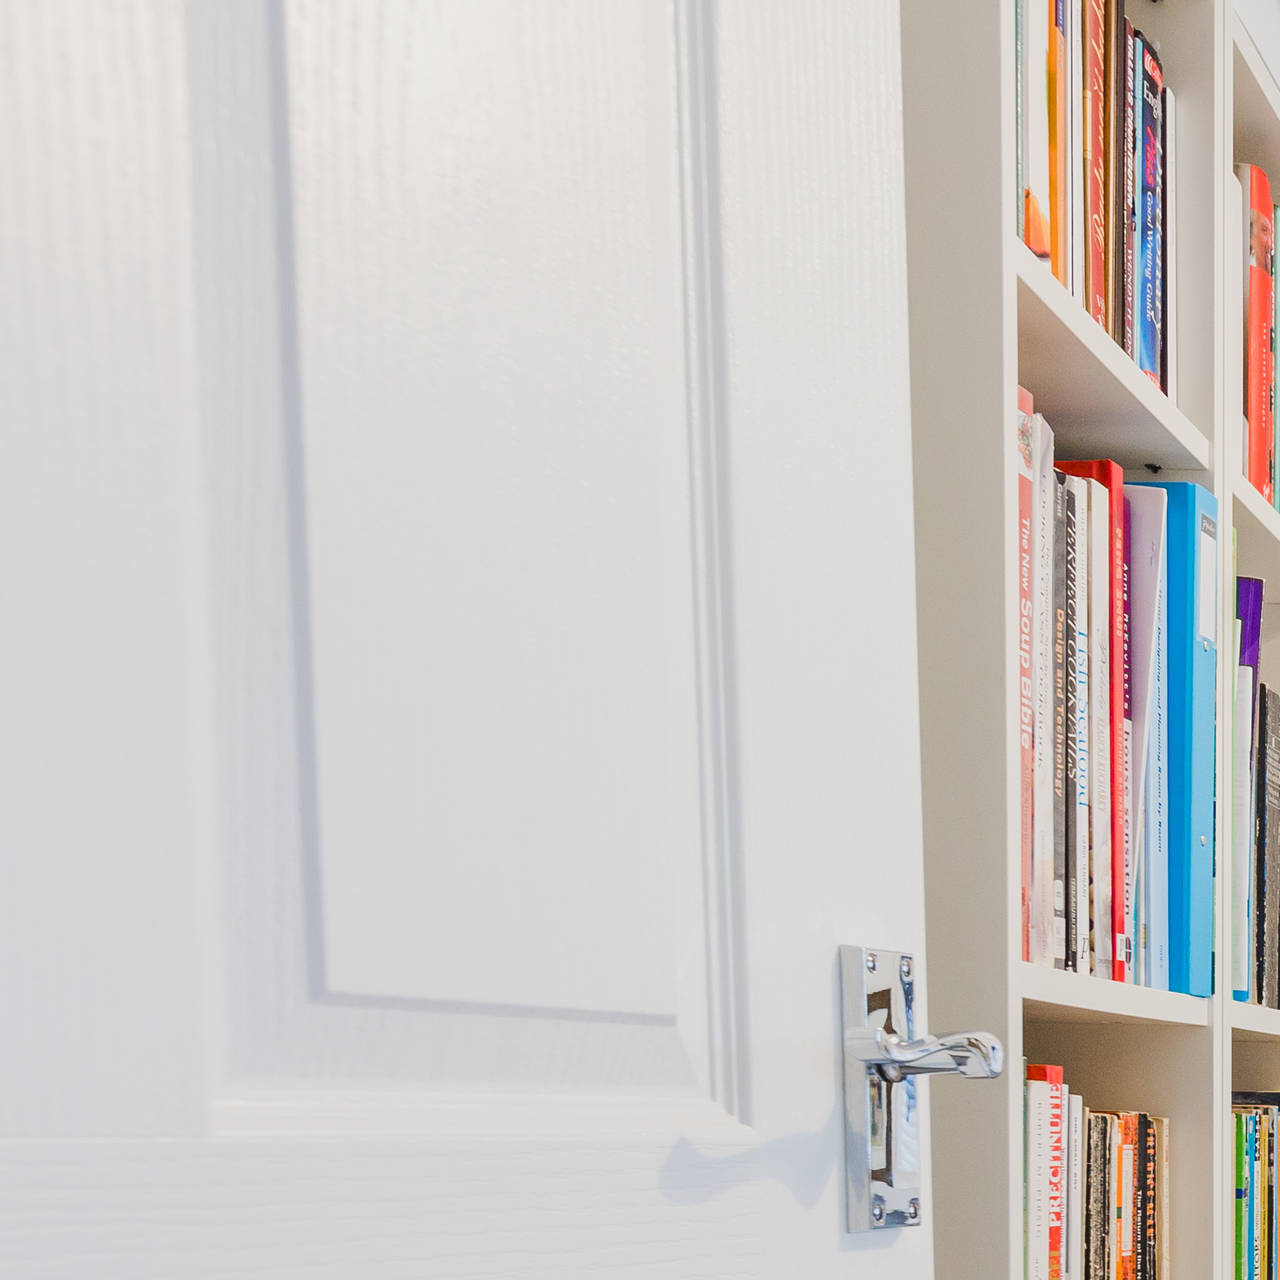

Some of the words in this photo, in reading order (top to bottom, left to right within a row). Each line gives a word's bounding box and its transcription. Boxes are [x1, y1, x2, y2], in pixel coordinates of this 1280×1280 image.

[1127, 34, 1135, 106] KILLER'S
[1126, 107, 1134, 209] COUNTDOWN
[1146, 191, 1154, 229] Good
[1144, 230, 1154, 281] Writing
[1146, 282, 1154, 323] Guide
[1021, 517, 1031, 550] The
[1021, 551, 1031, 592] New
[1067, 510, 1078, 635] PERFECT
[1122, 562, 1130, 602] Anne
[1018, 597, 1033, 670] Soup
[1055, 608, 1066, 662] Design
[1020, 676, 1032, 750] Bible
[1056, 668, 1066, 699] and
[1067, 638, 1078, 783] COCKTAILS
[1054, 704, 1066, 798] Technology
[1077, 697, 1089, 808] Seafood
[1123, 730, 1132, 797] house
[1123, 807, 1132, 916] sensation
